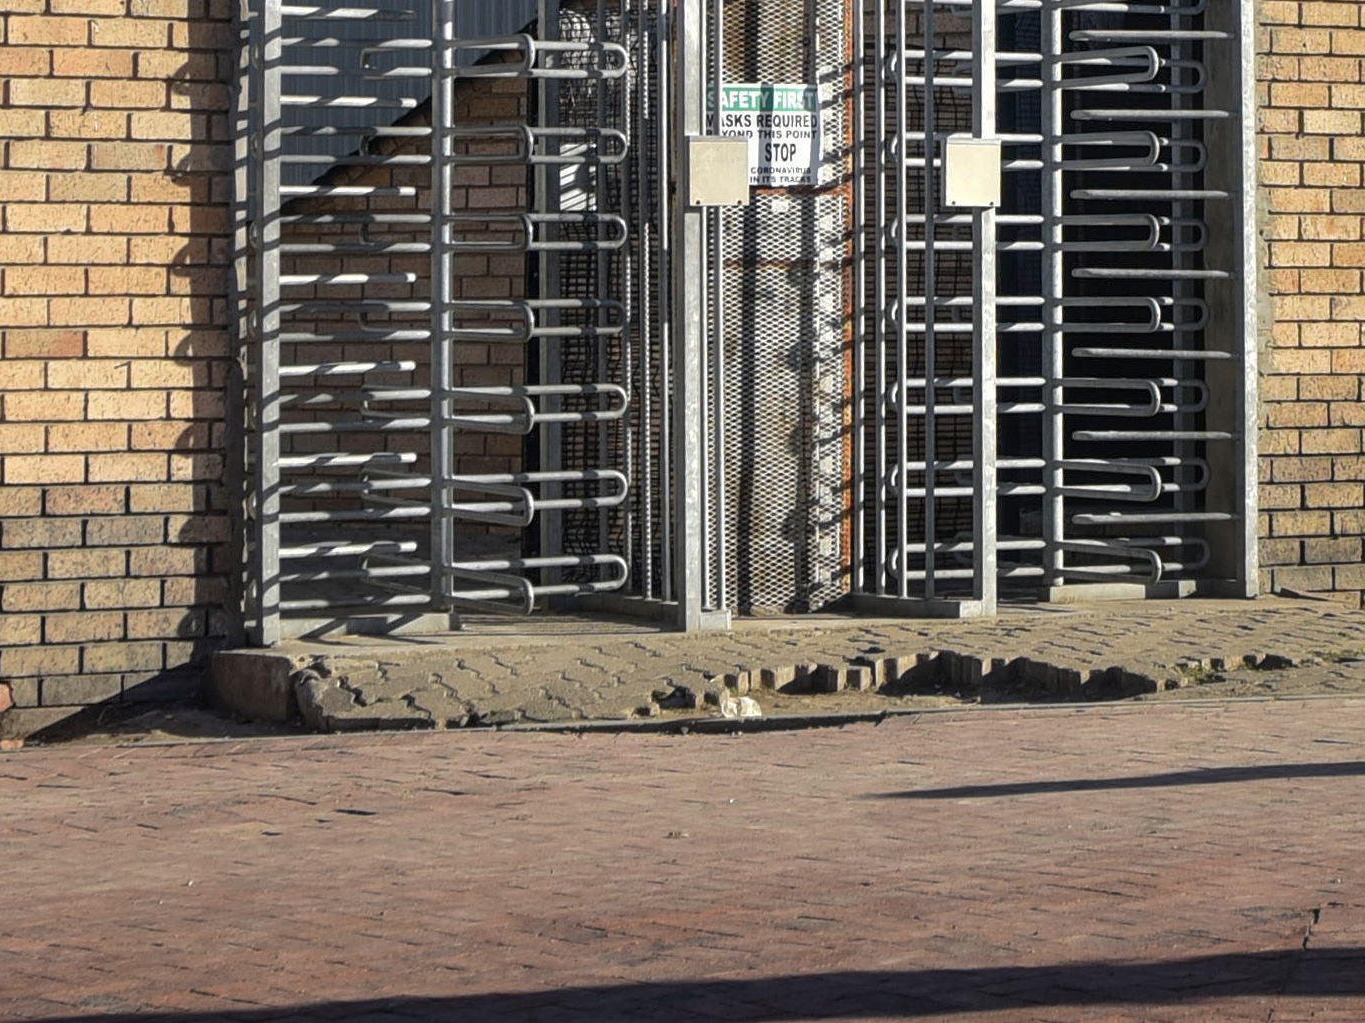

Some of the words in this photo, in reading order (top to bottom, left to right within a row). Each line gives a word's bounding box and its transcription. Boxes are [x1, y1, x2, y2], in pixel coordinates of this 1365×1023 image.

[707, 90, 770, 109] SAFETY
[774, 90, 814, 109] FIRST
[757, 114, 817, 128] REQUIRED
[706, 130, 753, 138] BYOND
[758, 130, 782, 139] THIS
[786, 130, 817, 139] POINT
[765, 143, 796, 162] STOP
